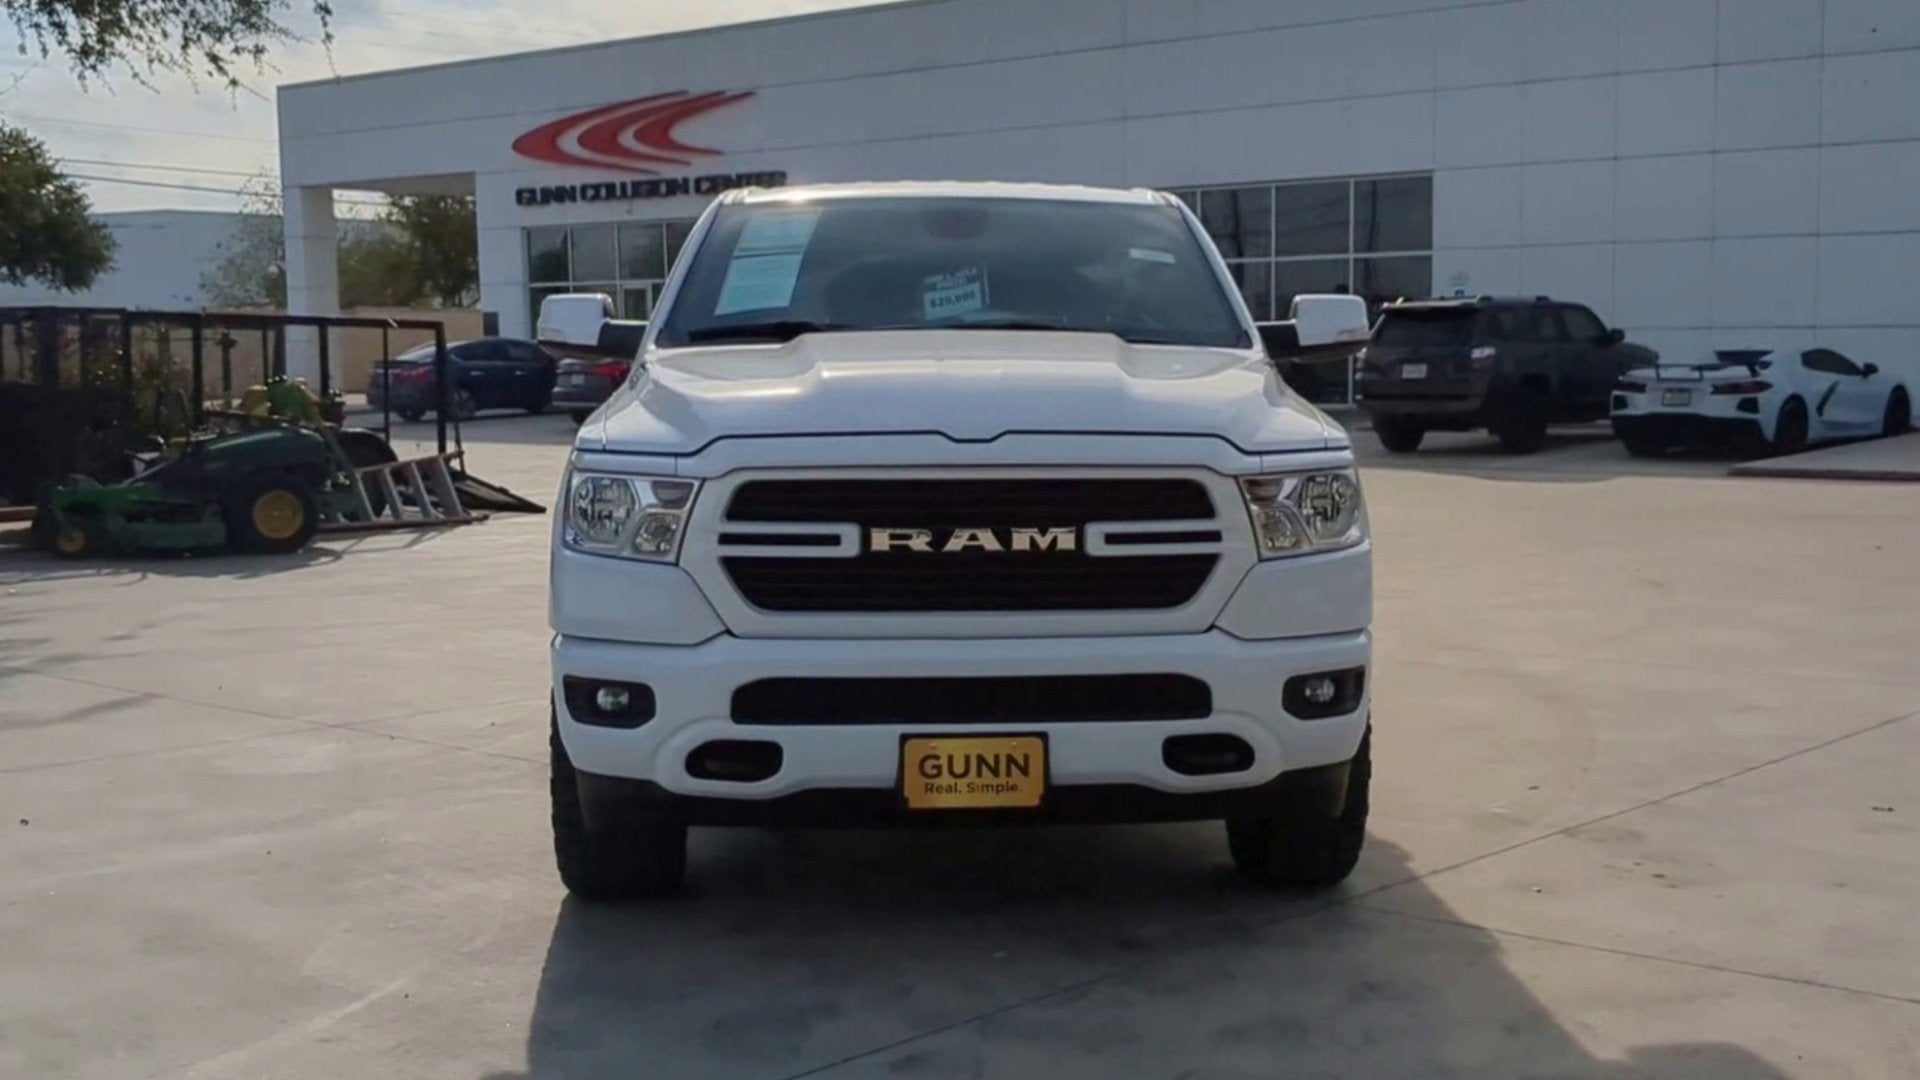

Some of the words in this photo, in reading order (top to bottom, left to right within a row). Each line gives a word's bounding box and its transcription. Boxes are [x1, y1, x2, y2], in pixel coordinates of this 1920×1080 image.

[515, 187, 577, 206] GUNN
[580, 177, 689, 200] COLLISION
[870, 528, 1076, 552] RAM
[918, 753, 1030, 779] GUNN
[924, 783, 962, 795] Real.
